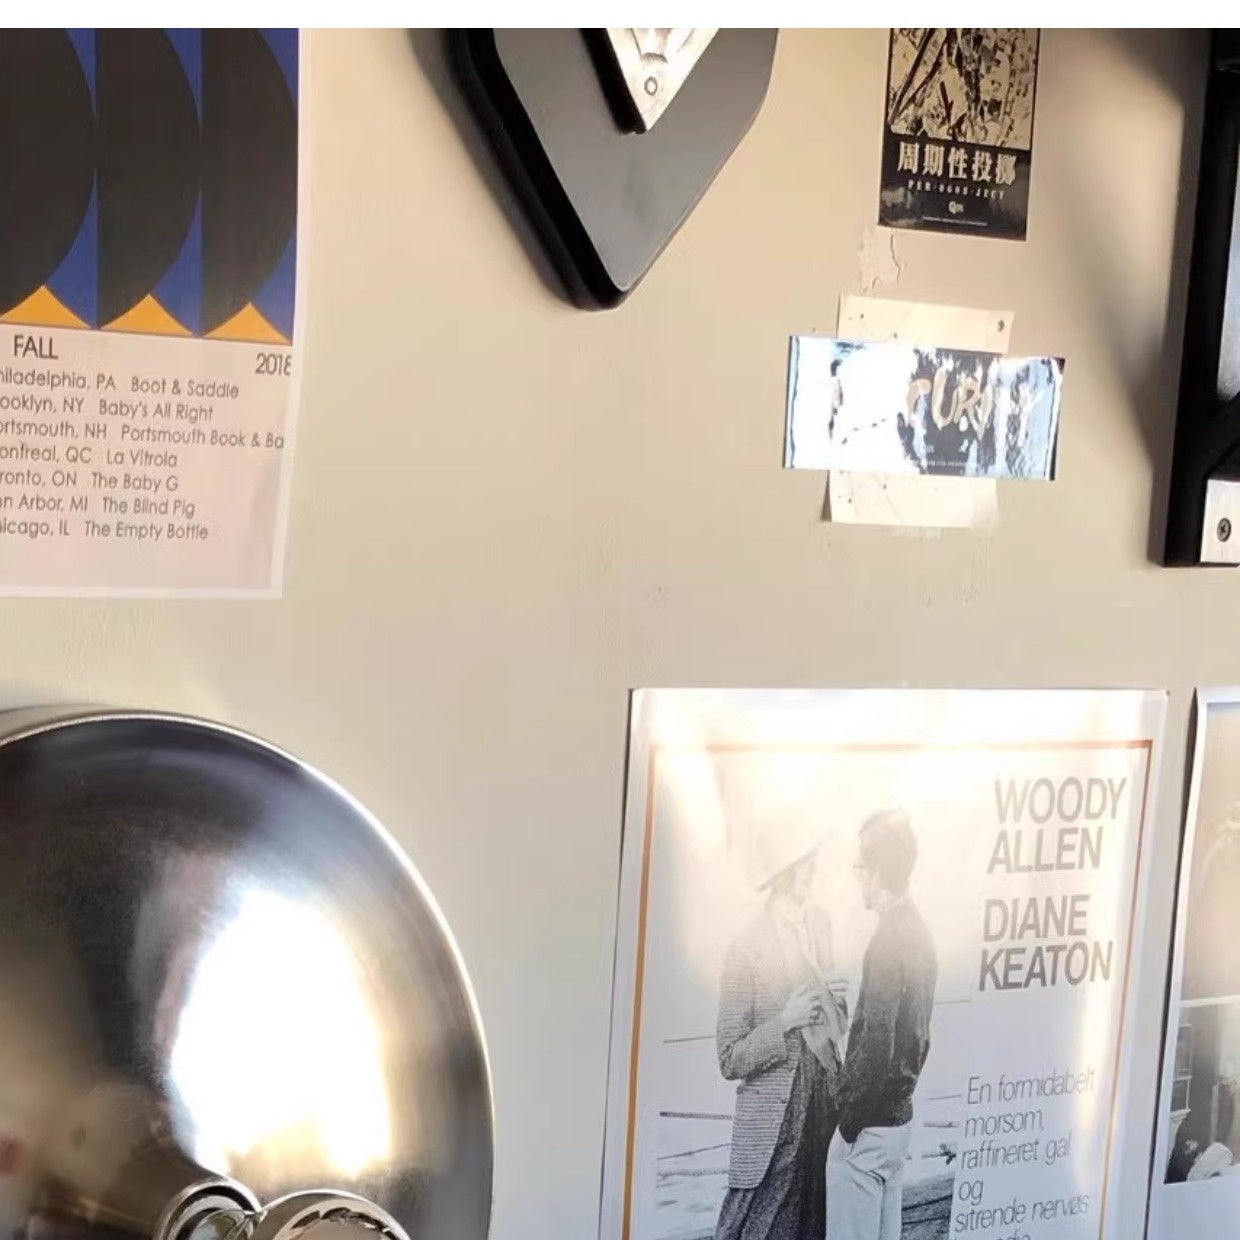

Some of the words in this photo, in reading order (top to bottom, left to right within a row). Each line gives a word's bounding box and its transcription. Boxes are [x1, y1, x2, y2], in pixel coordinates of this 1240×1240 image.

[13, 334, 59, 360] FALL
[96, 373, 116, 390] PA
[131, 376, 166, 394] Boot
[171, 379, 181, 395] &
[187, 379, 239, 399] Saddle
[63, 397, 85, 413] NY
[98, 398, 148, 420] Baby's
[152, 402, 171, 418] All
[175, 403, 213, 424] Right
[84, 422, 107, 440] NH
[121, 424, 206, 445] Portsmouth
[210, 430, 246, 447] Book
[251, 432, 260, 448] &
[65, 446, 92, 463] QC
[106, 449, 124, 465] La
[129, 449, 178, 468] Vitrola
[994, 777, 1127, 824] WOODY
[986, 826, 1104, 874] ALLEN
[983, 894, 1091, 942] DIANE
[978, 940, 1114, 991] KEATON
[967, 1075, 991, 1104] En
[959, 1179, 983, 1201] og
[955, 1200, 1026, 1233] sitrende
